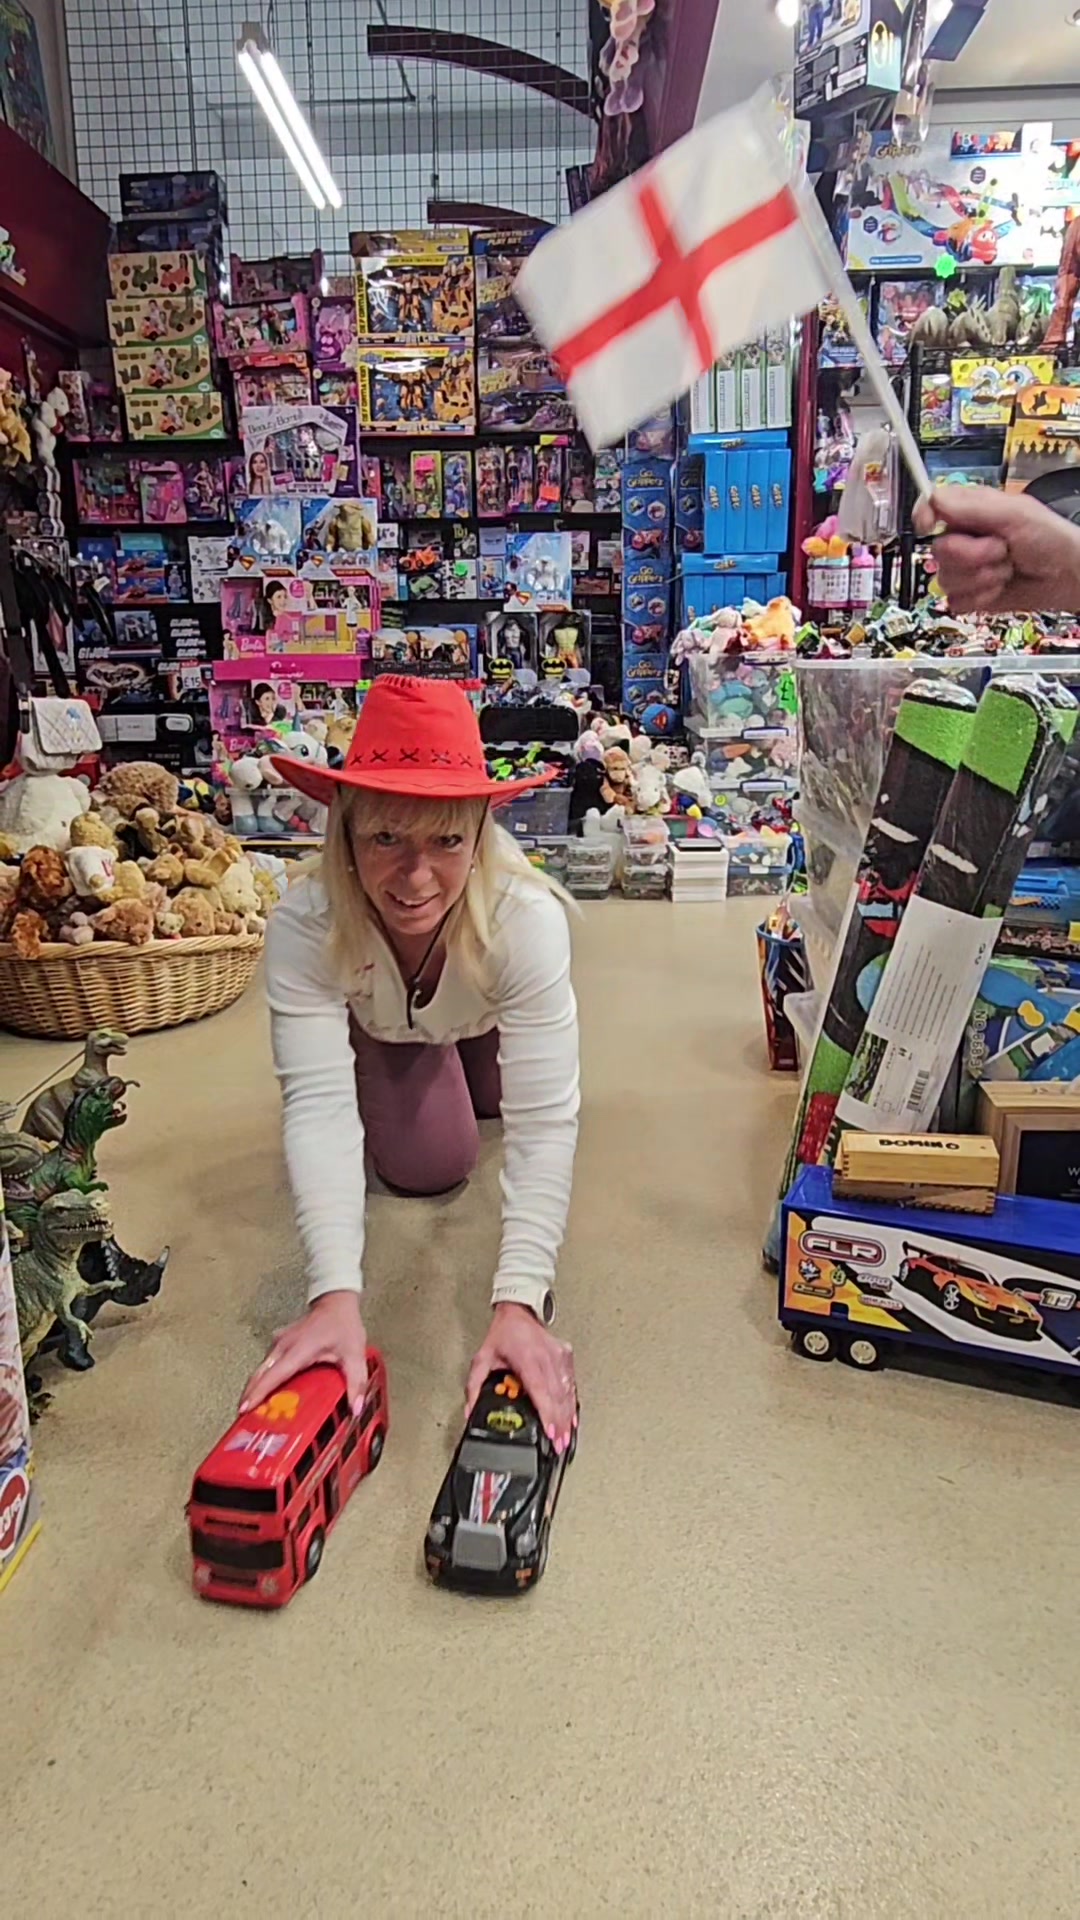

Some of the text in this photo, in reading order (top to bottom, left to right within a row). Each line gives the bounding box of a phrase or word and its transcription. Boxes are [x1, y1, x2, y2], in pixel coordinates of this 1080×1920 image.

[184, 676, 200, 687] £15
[879, 1138, 960, 1150] DOMINO
[807, 1238, 877, 1259] FLR
